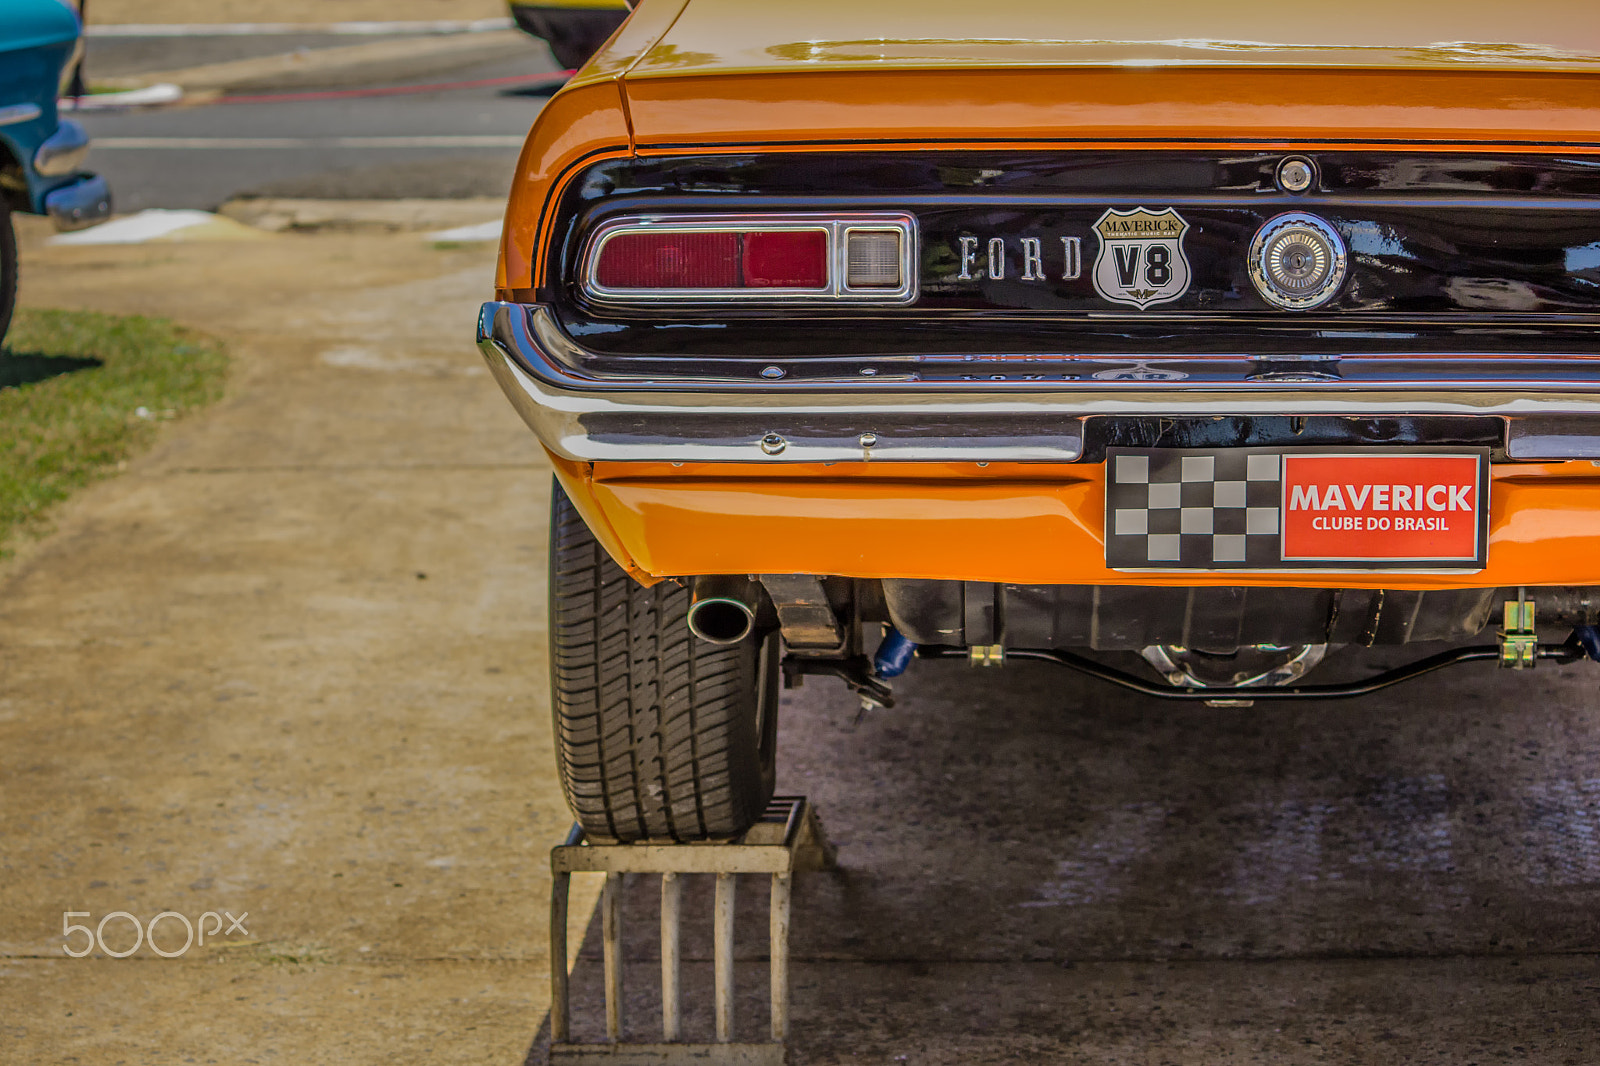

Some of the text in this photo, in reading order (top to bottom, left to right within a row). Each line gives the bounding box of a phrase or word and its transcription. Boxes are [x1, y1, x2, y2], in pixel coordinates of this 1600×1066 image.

[1105, 220, 1178, 232] MAVERICK
[958, 237, 1081, 280] FORD
[1111, 243, 1172, 288] V8
[1289, 484, 1473, 511] MAVERICK
[1312, 517, 1449, 531] CLUBE DO BRASIL
